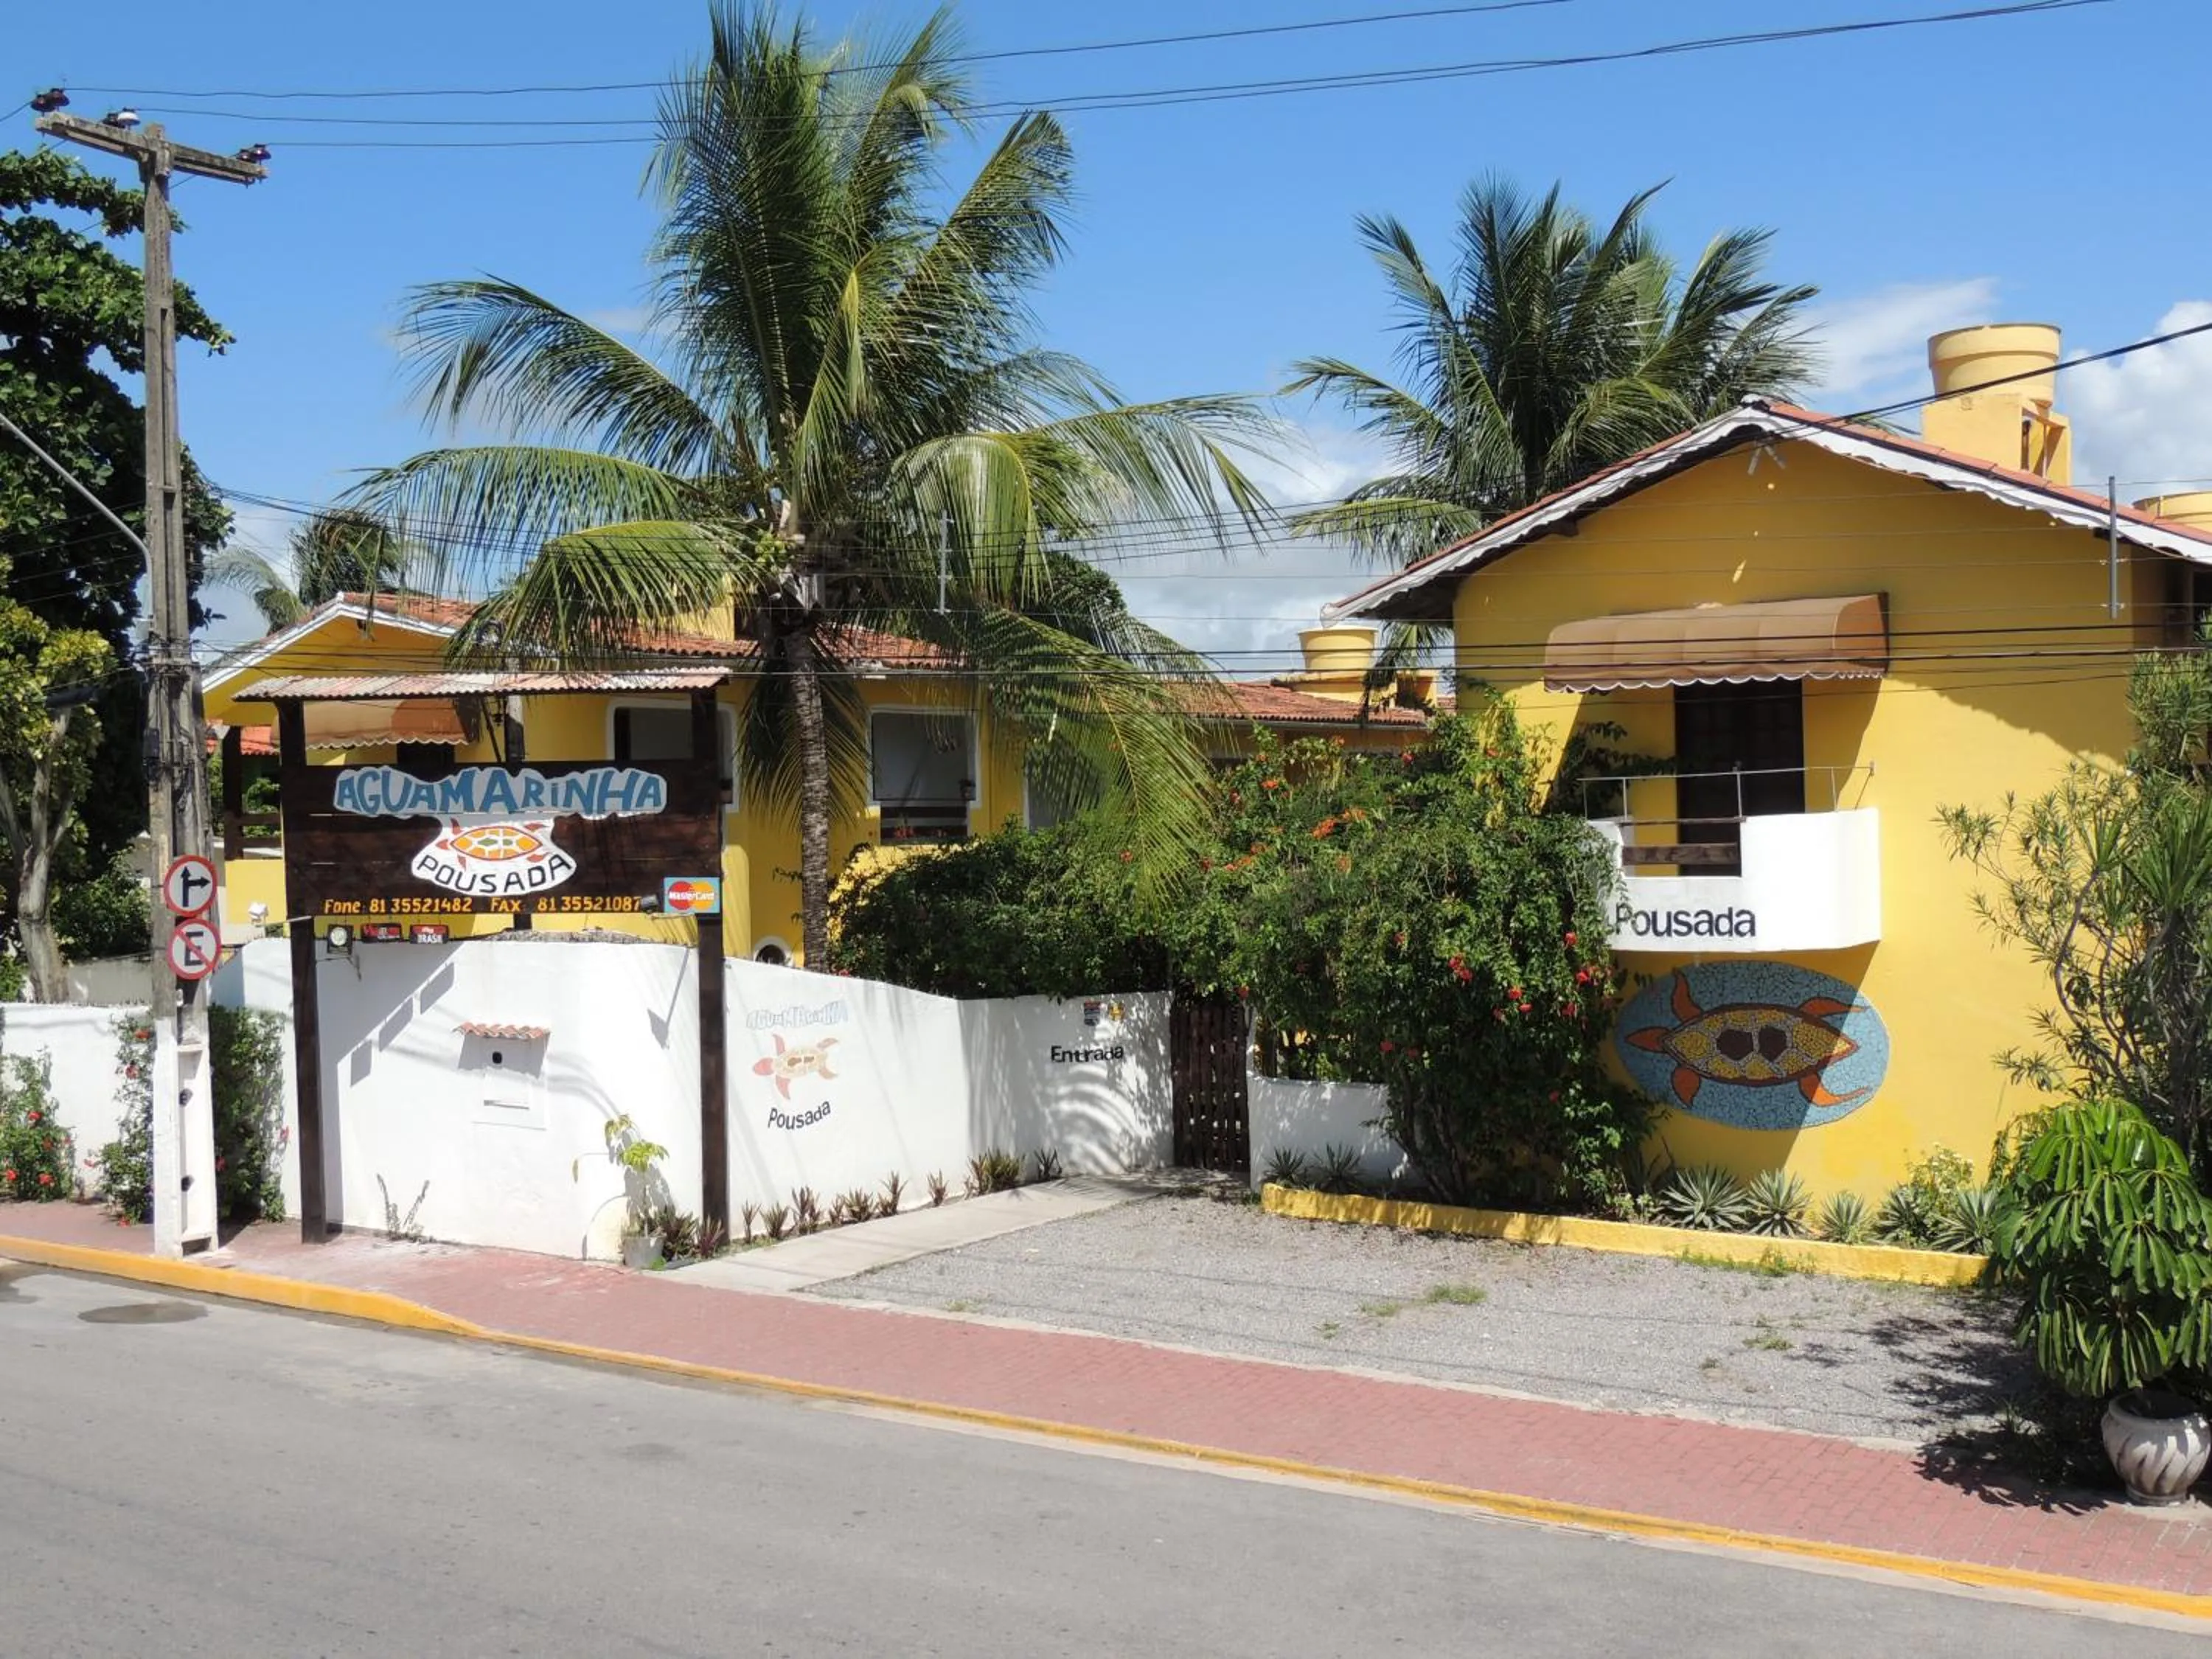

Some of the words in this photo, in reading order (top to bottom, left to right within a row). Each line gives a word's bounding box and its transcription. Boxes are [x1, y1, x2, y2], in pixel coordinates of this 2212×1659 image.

[336, 769, 662, 814] AGUAMARINHA
[417, 854, 572, 893] POUSADA
[369, 898, 386, 914] 81
[390, 897, 473, 913] 35521482
[537, 897, 557, 912] 81
[560, 895, 642, 911] 35521087
[1615, 902, 1756, 938] Pousada
[1051, 1045, 1124, 1063] Entrada
[767, 1101, 832, 1130] Pousada
